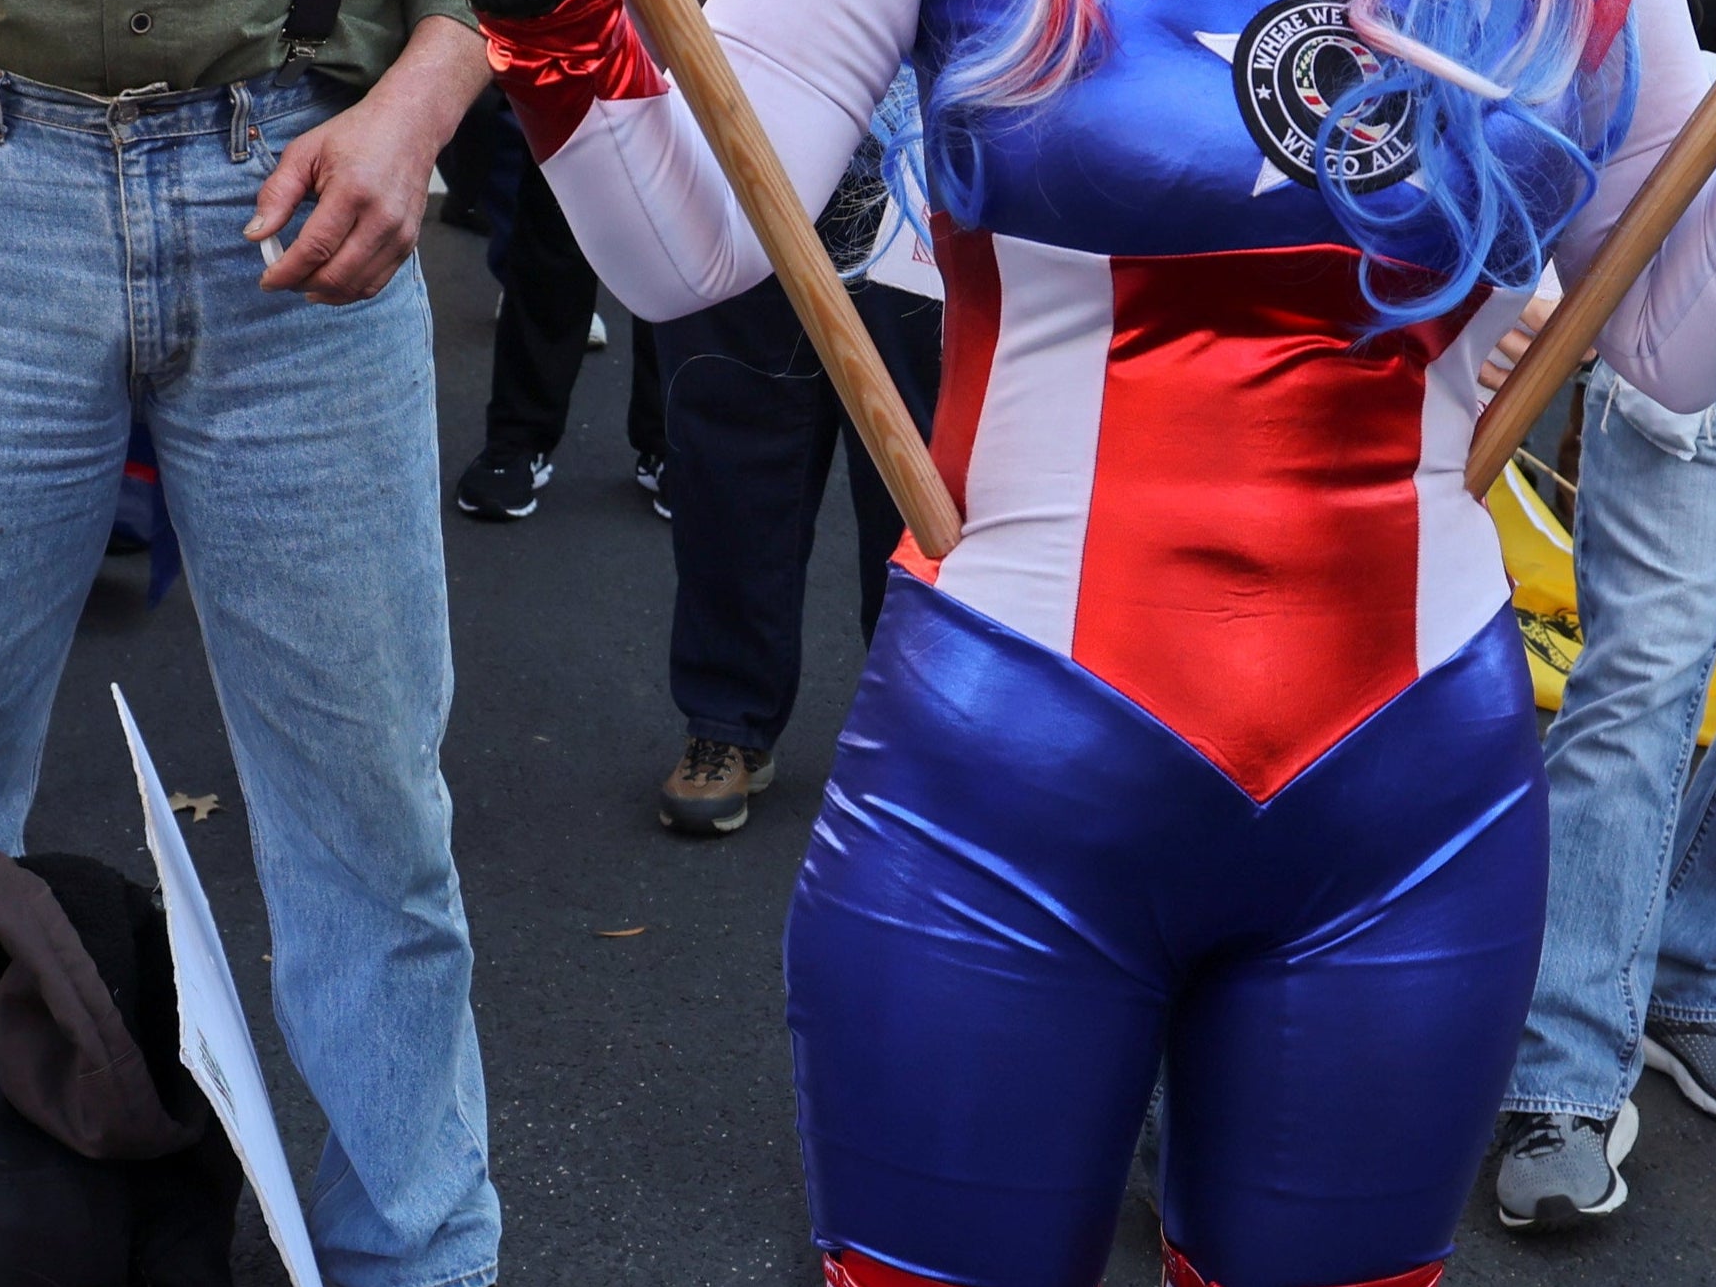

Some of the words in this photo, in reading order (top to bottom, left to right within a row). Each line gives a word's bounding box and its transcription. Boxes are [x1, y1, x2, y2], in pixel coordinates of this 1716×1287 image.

[1252, 12, 1309, 71] WHERE
[1307, 7, 1344, 26] WE
[1281, 127, 1316, 164] WE
[1324, 154, 1361, 176] GO
[1371, 134, 1412, 173] ALL
